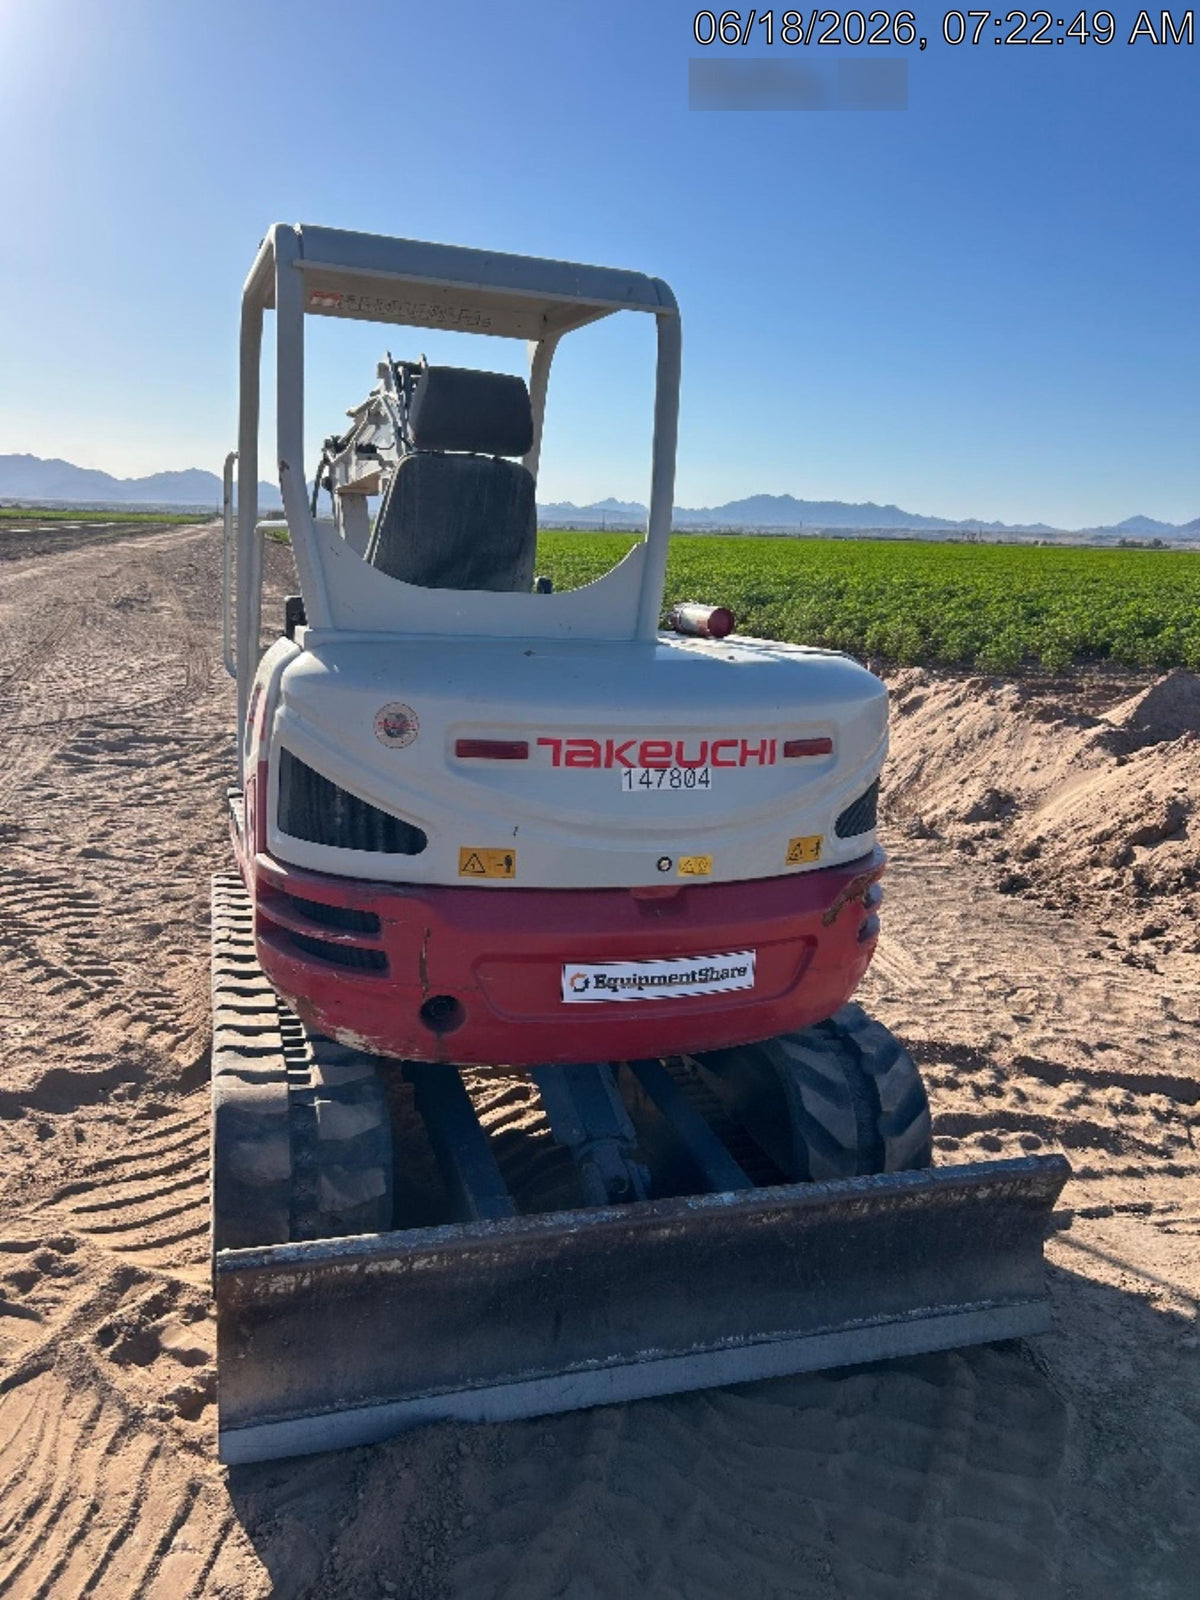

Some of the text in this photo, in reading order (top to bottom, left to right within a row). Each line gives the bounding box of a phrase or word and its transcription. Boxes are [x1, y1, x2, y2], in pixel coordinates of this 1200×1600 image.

[537, 738, 777, 768] TAKEUCHI
[624, 768, 710, 789] 147804
[593, 965, 748, 992] EquipmentShare
